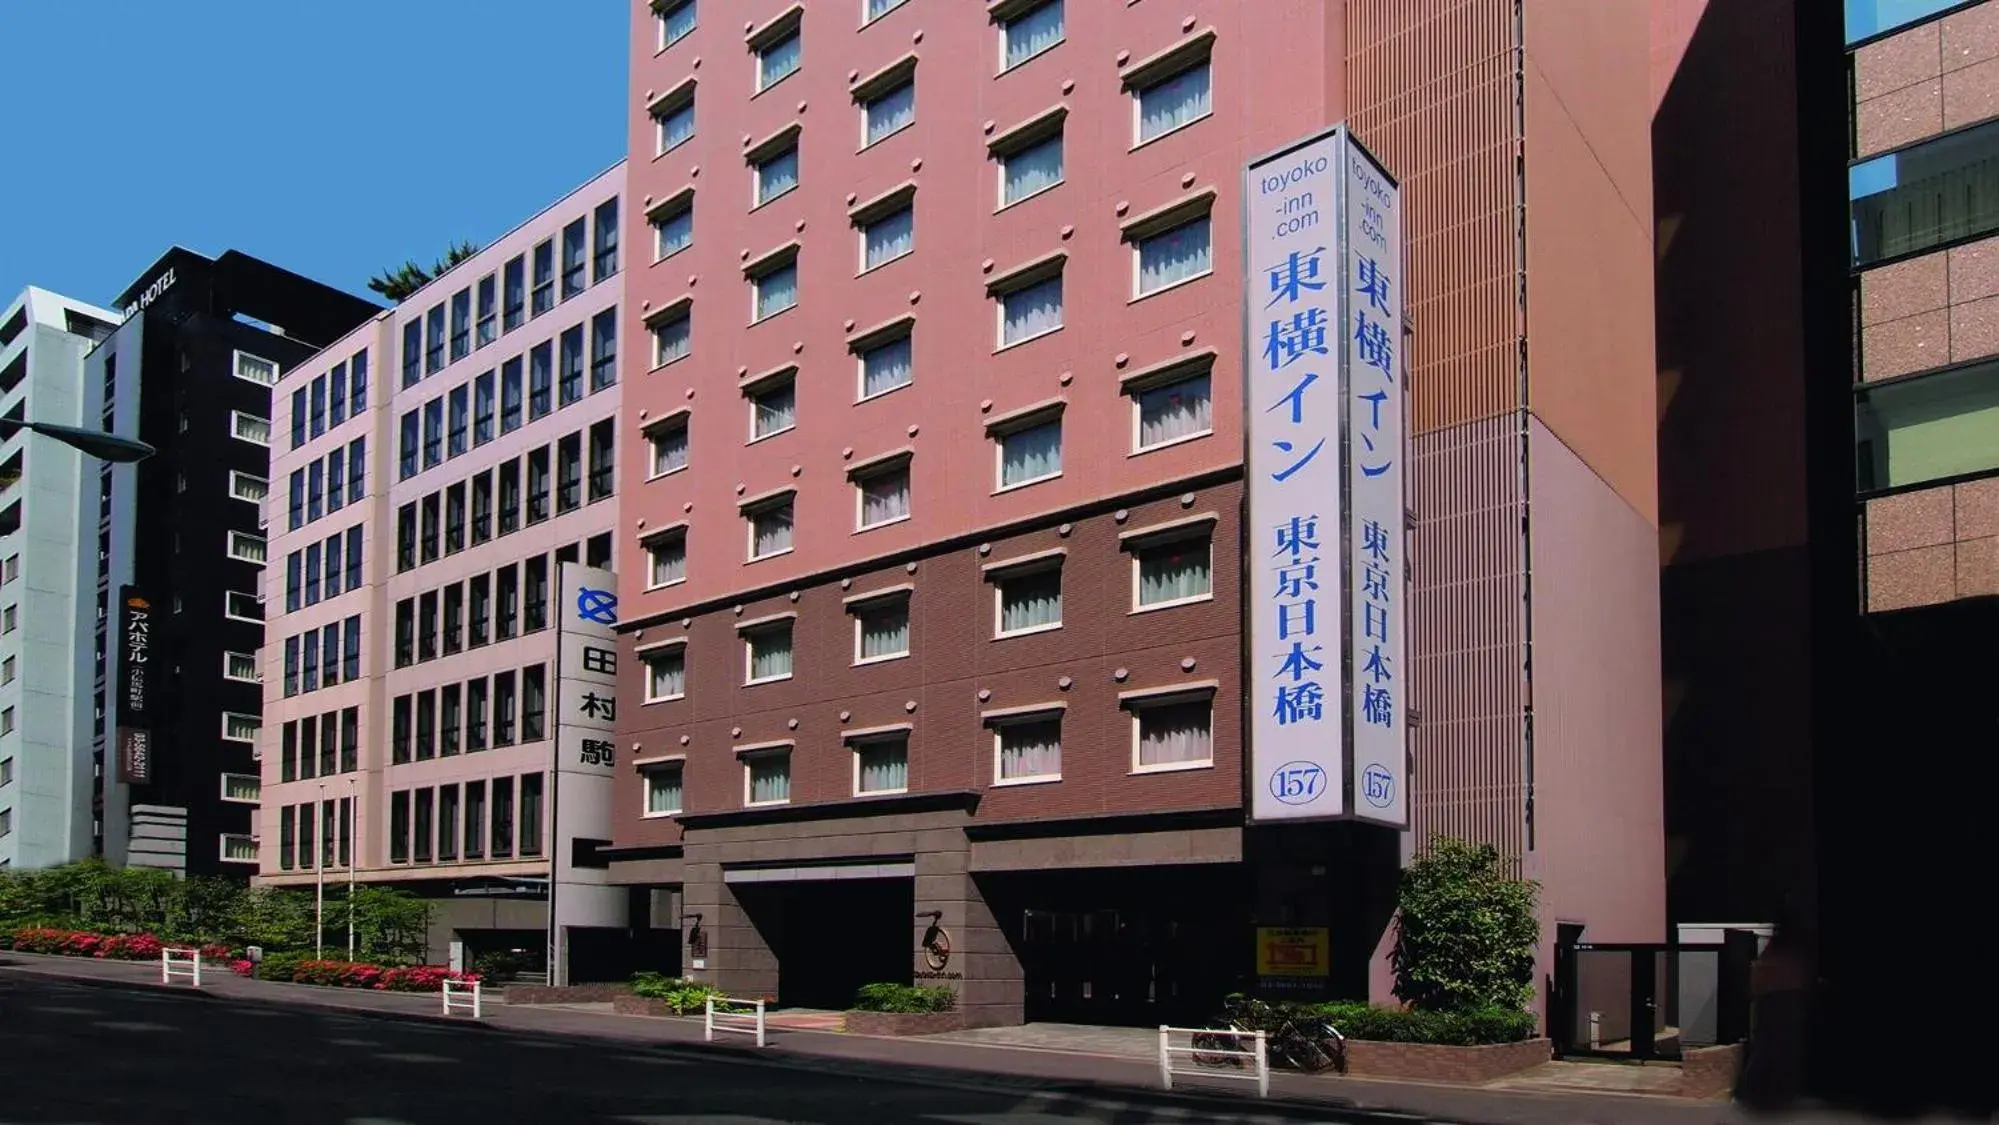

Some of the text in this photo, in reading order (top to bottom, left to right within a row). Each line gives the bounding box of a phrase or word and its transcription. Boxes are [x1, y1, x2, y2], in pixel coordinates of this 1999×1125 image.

[1261, 155, 1328, 194] toyoko
[1351, 155, 1392, 209] toyoko
[1275, 190, 1313, 216] -inn
[1360, 200, 1384, 230] -inn
[1271, 208, 1320, 240] .com
[1358, 219, 1388, 254] .com
[140, 266, 177, 309] HOTEL
[1262, 246, 1329, 726] 東横イン 東京日本橋
[1353, 248, 1394, 729] 東横イン 東京日本橋
[128, 610, 149, 663] アパホテル
[579, 646, 617, 767] 田村駒
[1277, 767, 1320, 797] 157
[1365, 768, 1392, 800] 157
